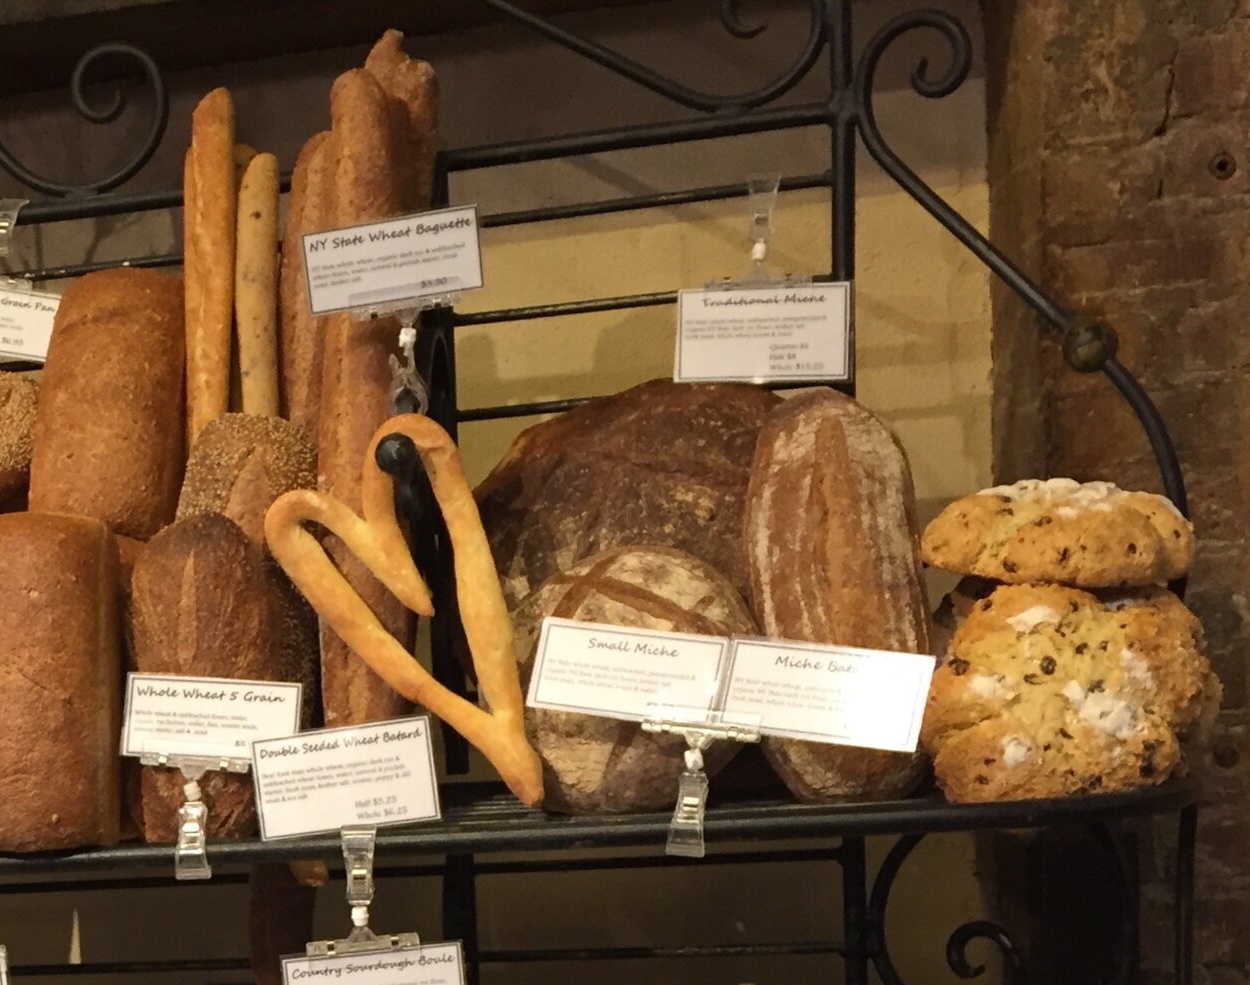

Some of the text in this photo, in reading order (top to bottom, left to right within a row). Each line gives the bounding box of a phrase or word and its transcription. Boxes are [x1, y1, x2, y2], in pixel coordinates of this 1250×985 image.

[309, 217, 472, 253] NY State Wheat Baguette
[0, 297, 32, 309] Grain
[34, 301, 56, 313] Pan
[587, 637, 679, 658] Small Miche
[774, 655, 822, 670] Miche
[136, 685, 286, 703] Whole Wheat 5 Grain
[259, 727, 423, 760] Double Seeded Wheat Batard
[356, 810, 381, 820] Whole
[291, 952, 454, 980] Country Sourdough Boule
